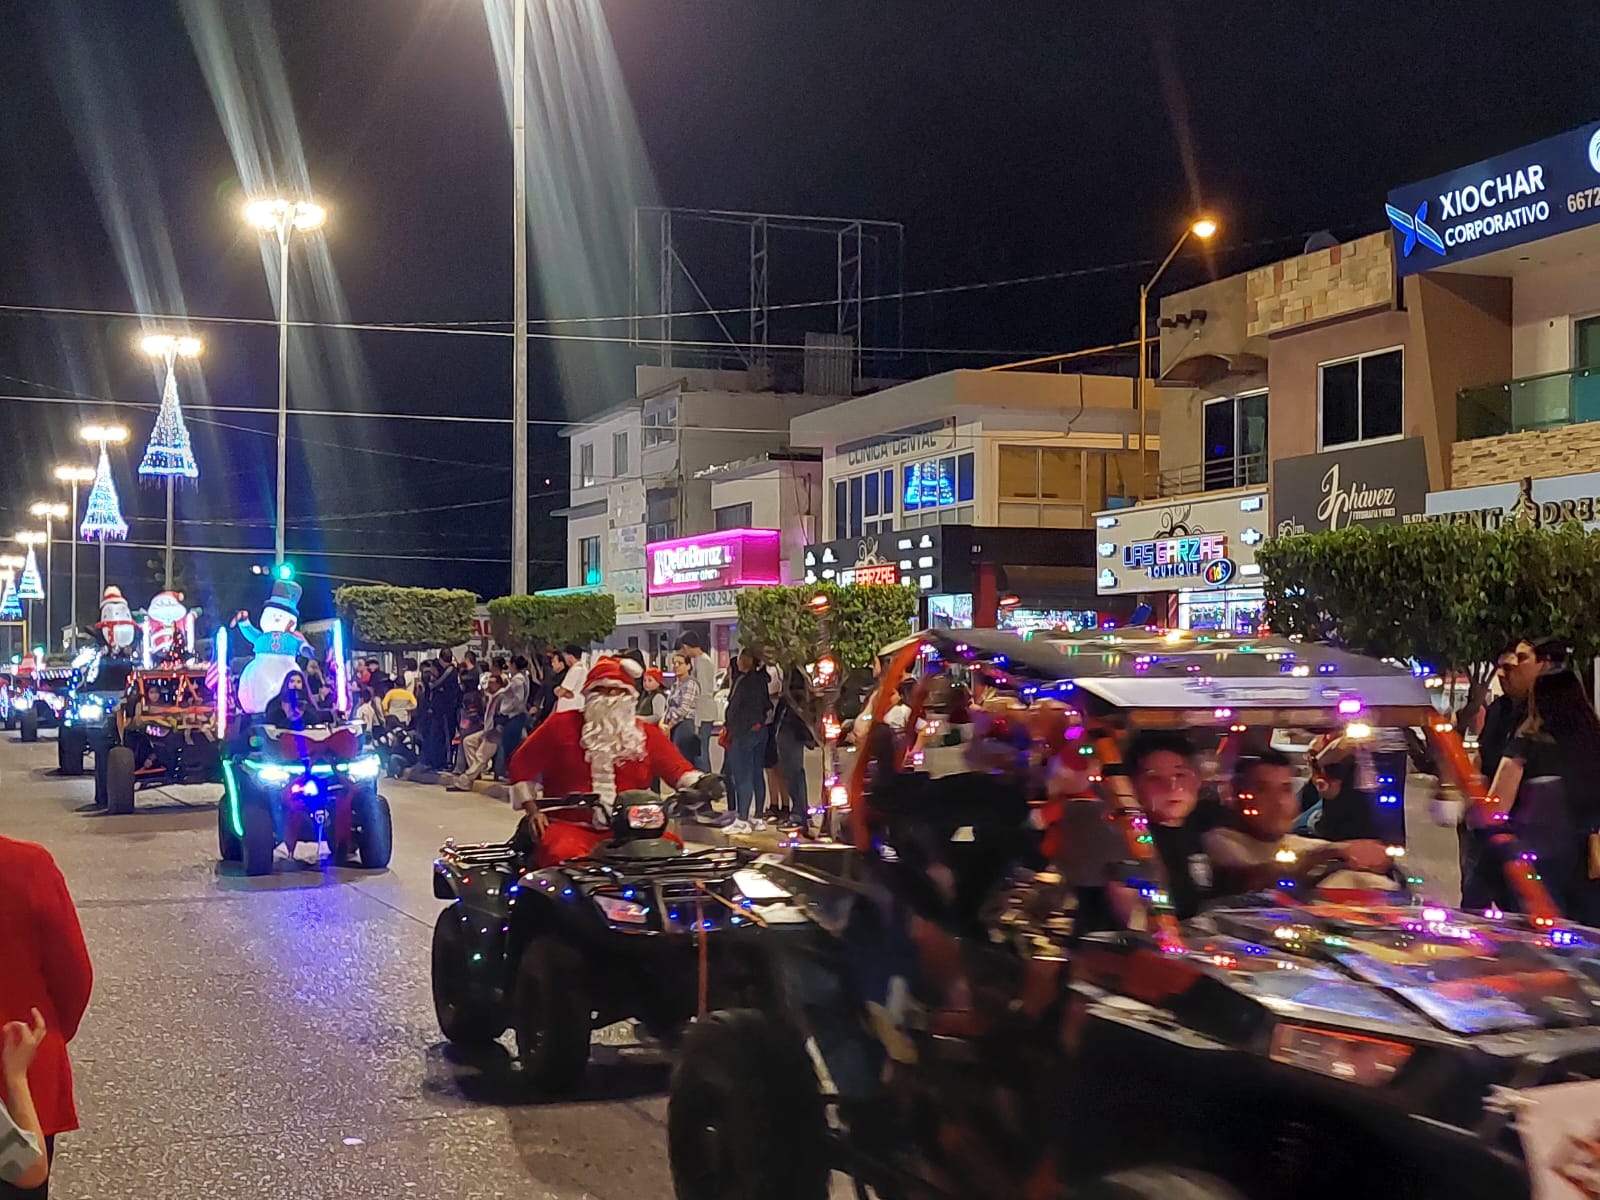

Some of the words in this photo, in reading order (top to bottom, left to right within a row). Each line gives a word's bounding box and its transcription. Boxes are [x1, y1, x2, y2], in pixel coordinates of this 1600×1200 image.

[1439, 165, 1545, 220] XIOCHAR
[1445, 201, 1549, 246] CORPORATIVO
[893, 430, 936, 456] DENTAL
[1122, 543, 1155, 567] LAS
[1156, 535, 1227, 564] GARZAS
[856, 565, 897, 586] GARZAS
[1147, 562, 1199, 578] BOUTIQUE
